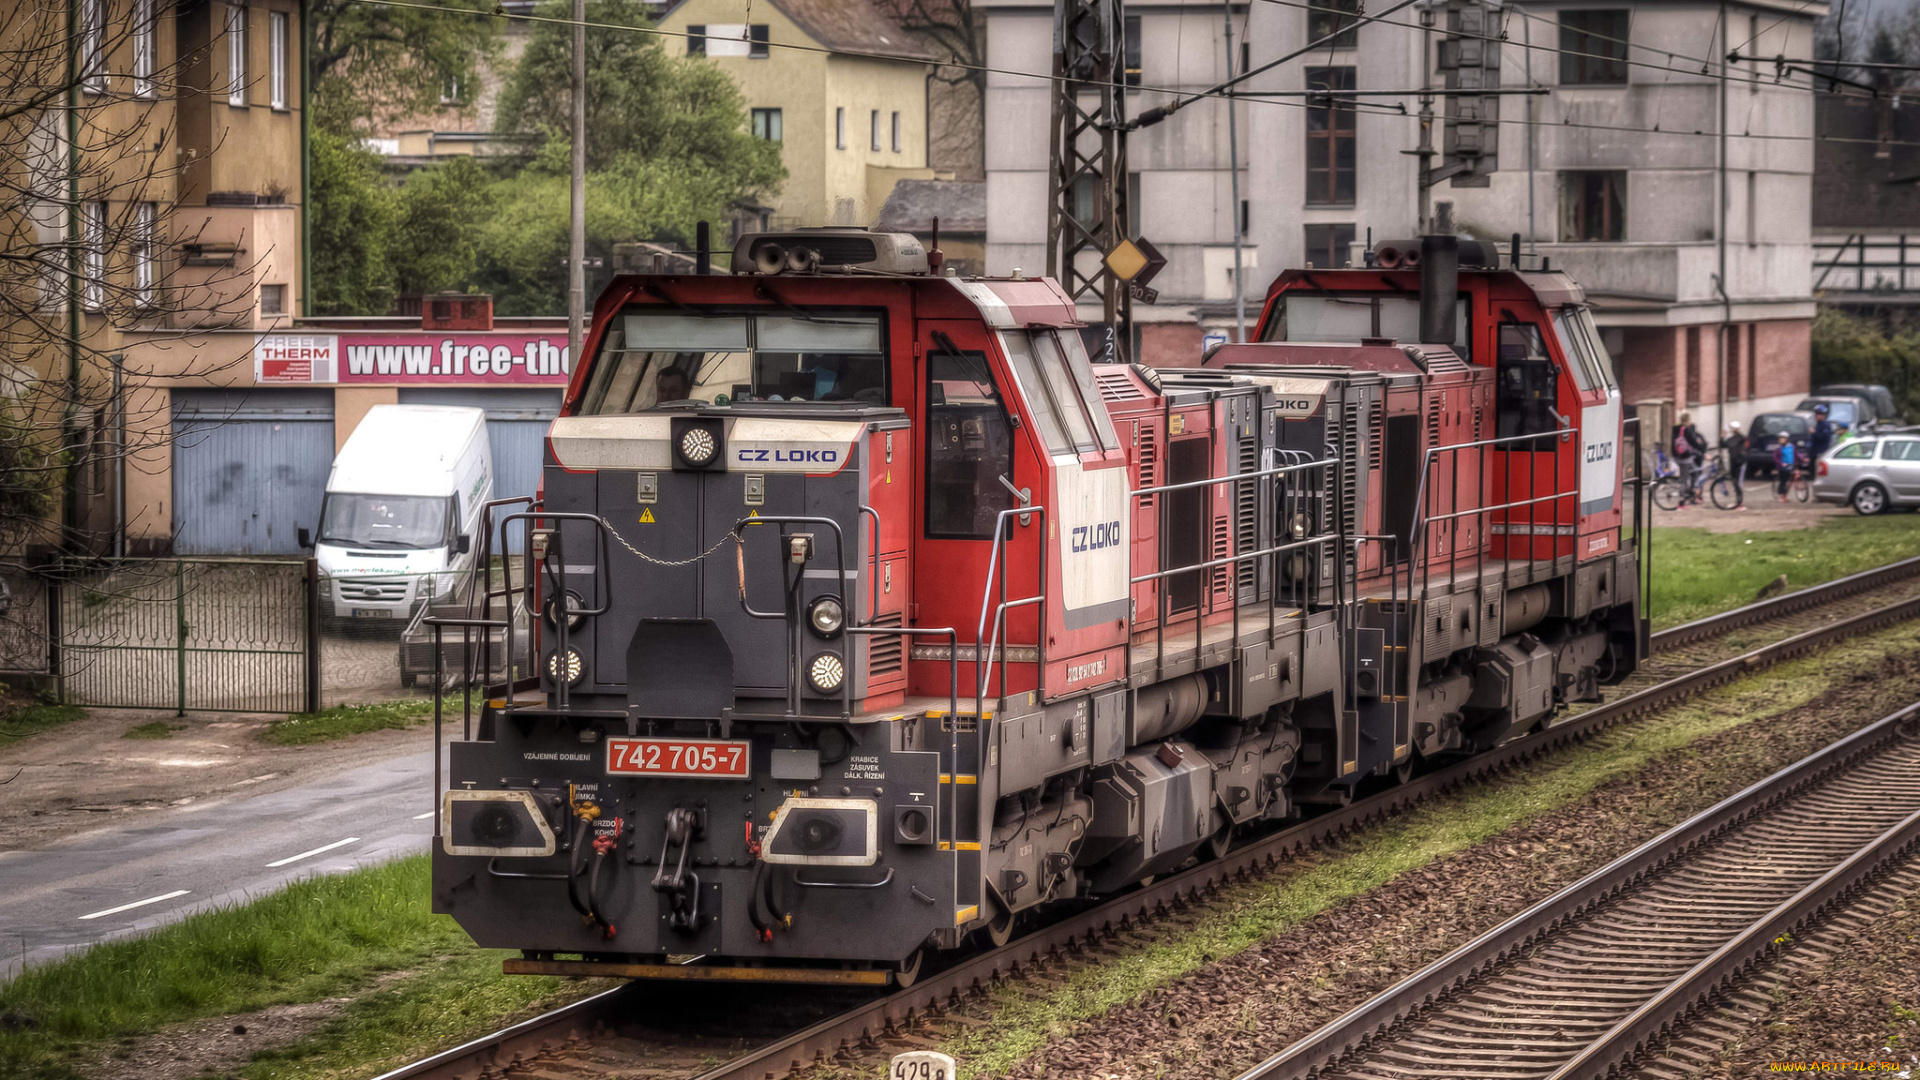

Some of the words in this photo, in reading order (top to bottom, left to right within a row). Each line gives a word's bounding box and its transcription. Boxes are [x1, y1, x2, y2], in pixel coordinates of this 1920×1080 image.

[262, 348, 330, 358] THERM
[1275, 400, 1309, 409] OKO
[738, 450, 770, 461] CZ
[775, 450, 837, 462] LOKO
[1072, 526, 1088, 553] CZ
[1089, 520, 1120, 550] LOKO
[523, 751, 558, 761] VZÁJEMNÉ
[559, 752, 591, 761] DOBÍJENÍ
[613, 744, 661, 769] 742
[668, 745, 743, 771] 705-7
[850, 763, 879, 771] ZÁSUVEK
[782, 789, 809, 797] HLNÍ
[895, 1061, 930, 1080] 429
